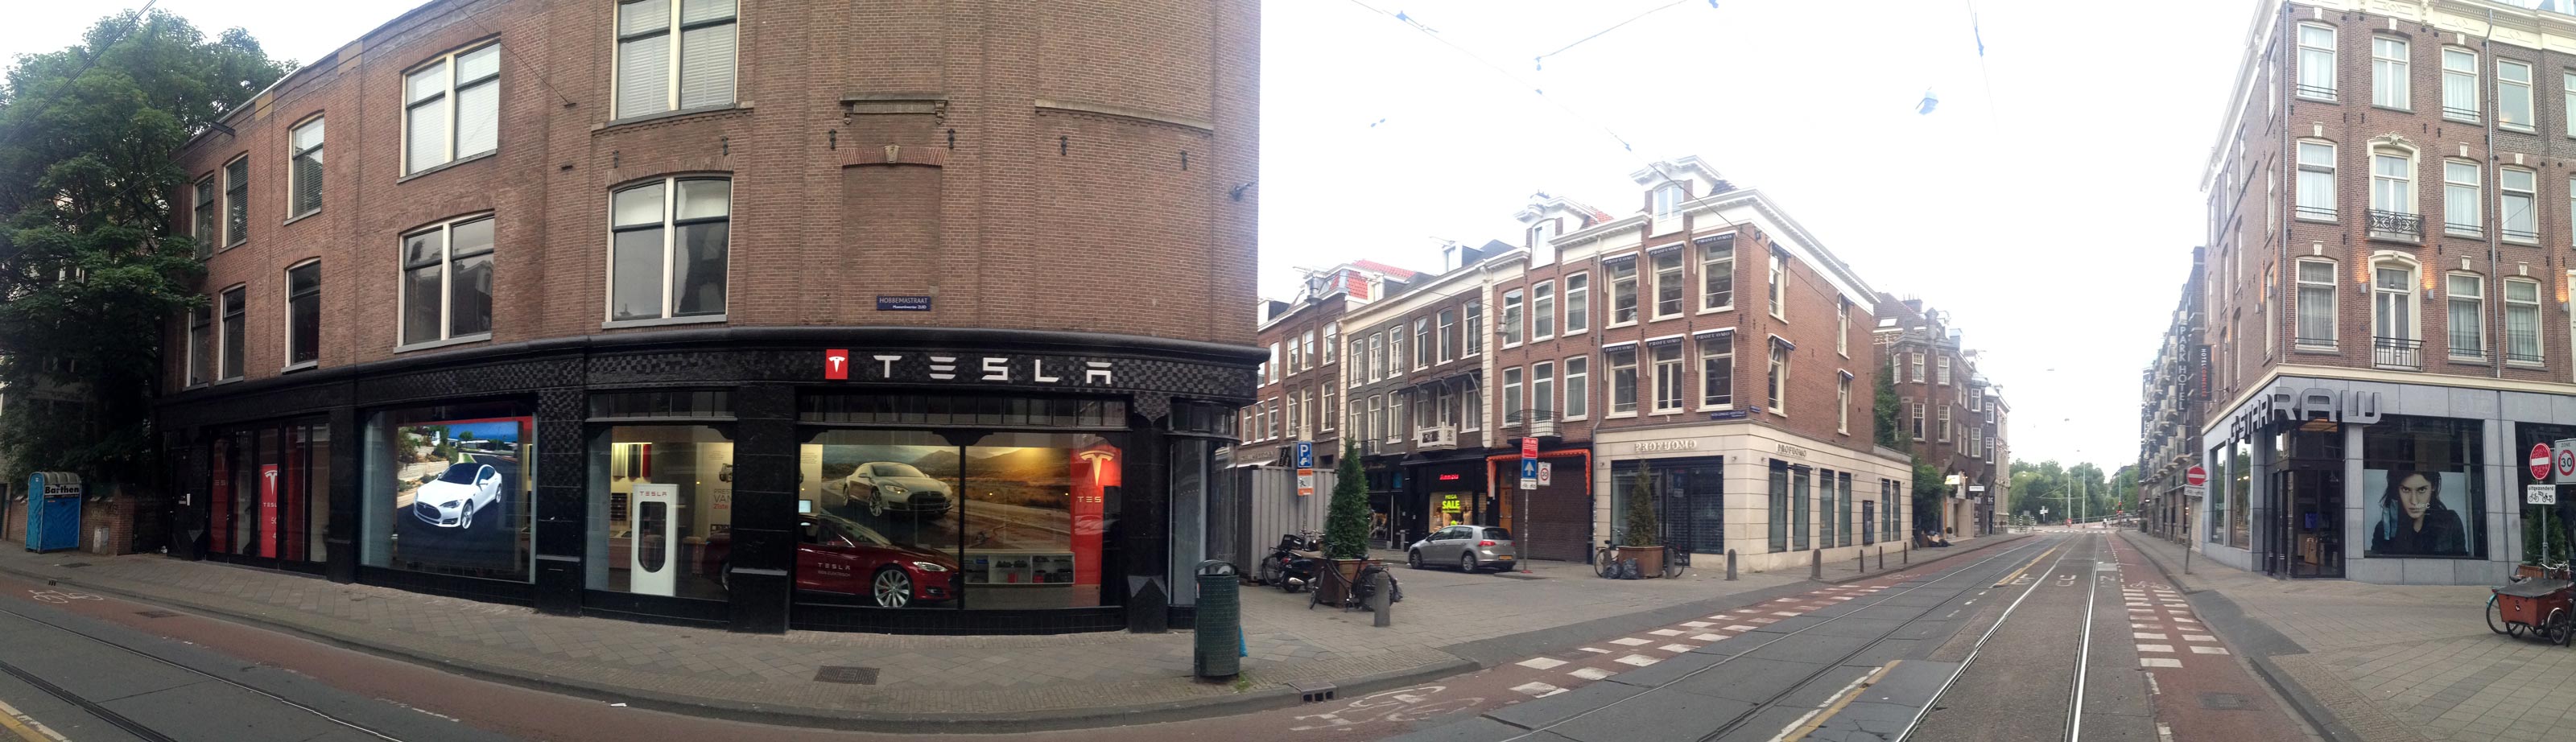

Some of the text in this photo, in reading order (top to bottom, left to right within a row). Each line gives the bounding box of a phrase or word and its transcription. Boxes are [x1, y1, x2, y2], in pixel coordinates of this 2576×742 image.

[873, 355, 1112, 385] TESLA
[2178, 326, 2187, 410] PARK HOTEL
[2273, 386, 2381, 424] RAW
[1300, 444, 1308, 457] P
[1634, 439, 1698, 452] PROFUOMO
[1777, 443, 1807, 458] PROFUOMO
[2561, 457, 2573, 468] 30
[45, 484, 80, 493] Barthen
[1442, 501, 1460, 509] SALE
